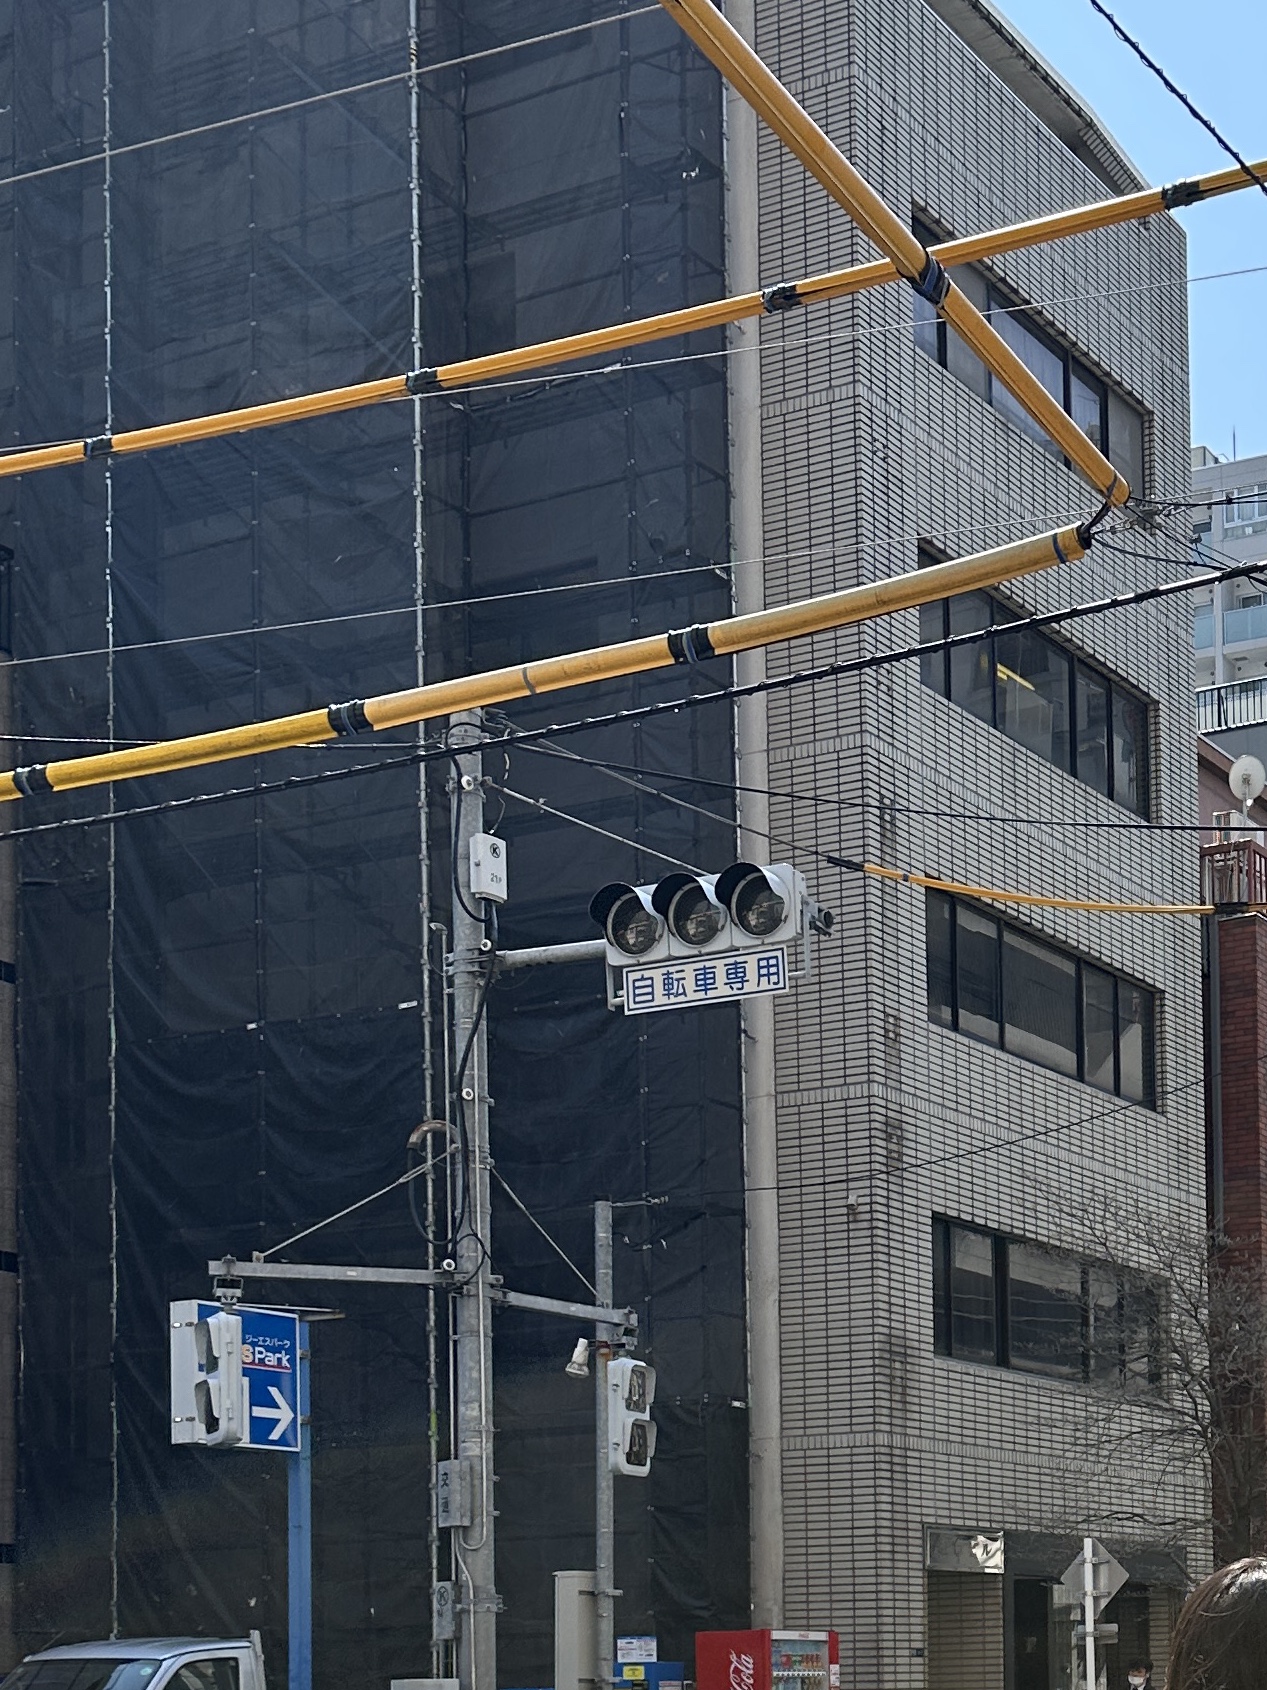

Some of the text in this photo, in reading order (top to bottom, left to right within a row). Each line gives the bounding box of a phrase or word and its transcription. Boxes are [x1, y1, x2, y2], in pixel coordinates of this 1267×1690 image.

[632, 954, 781, 1005] 自転車専用
